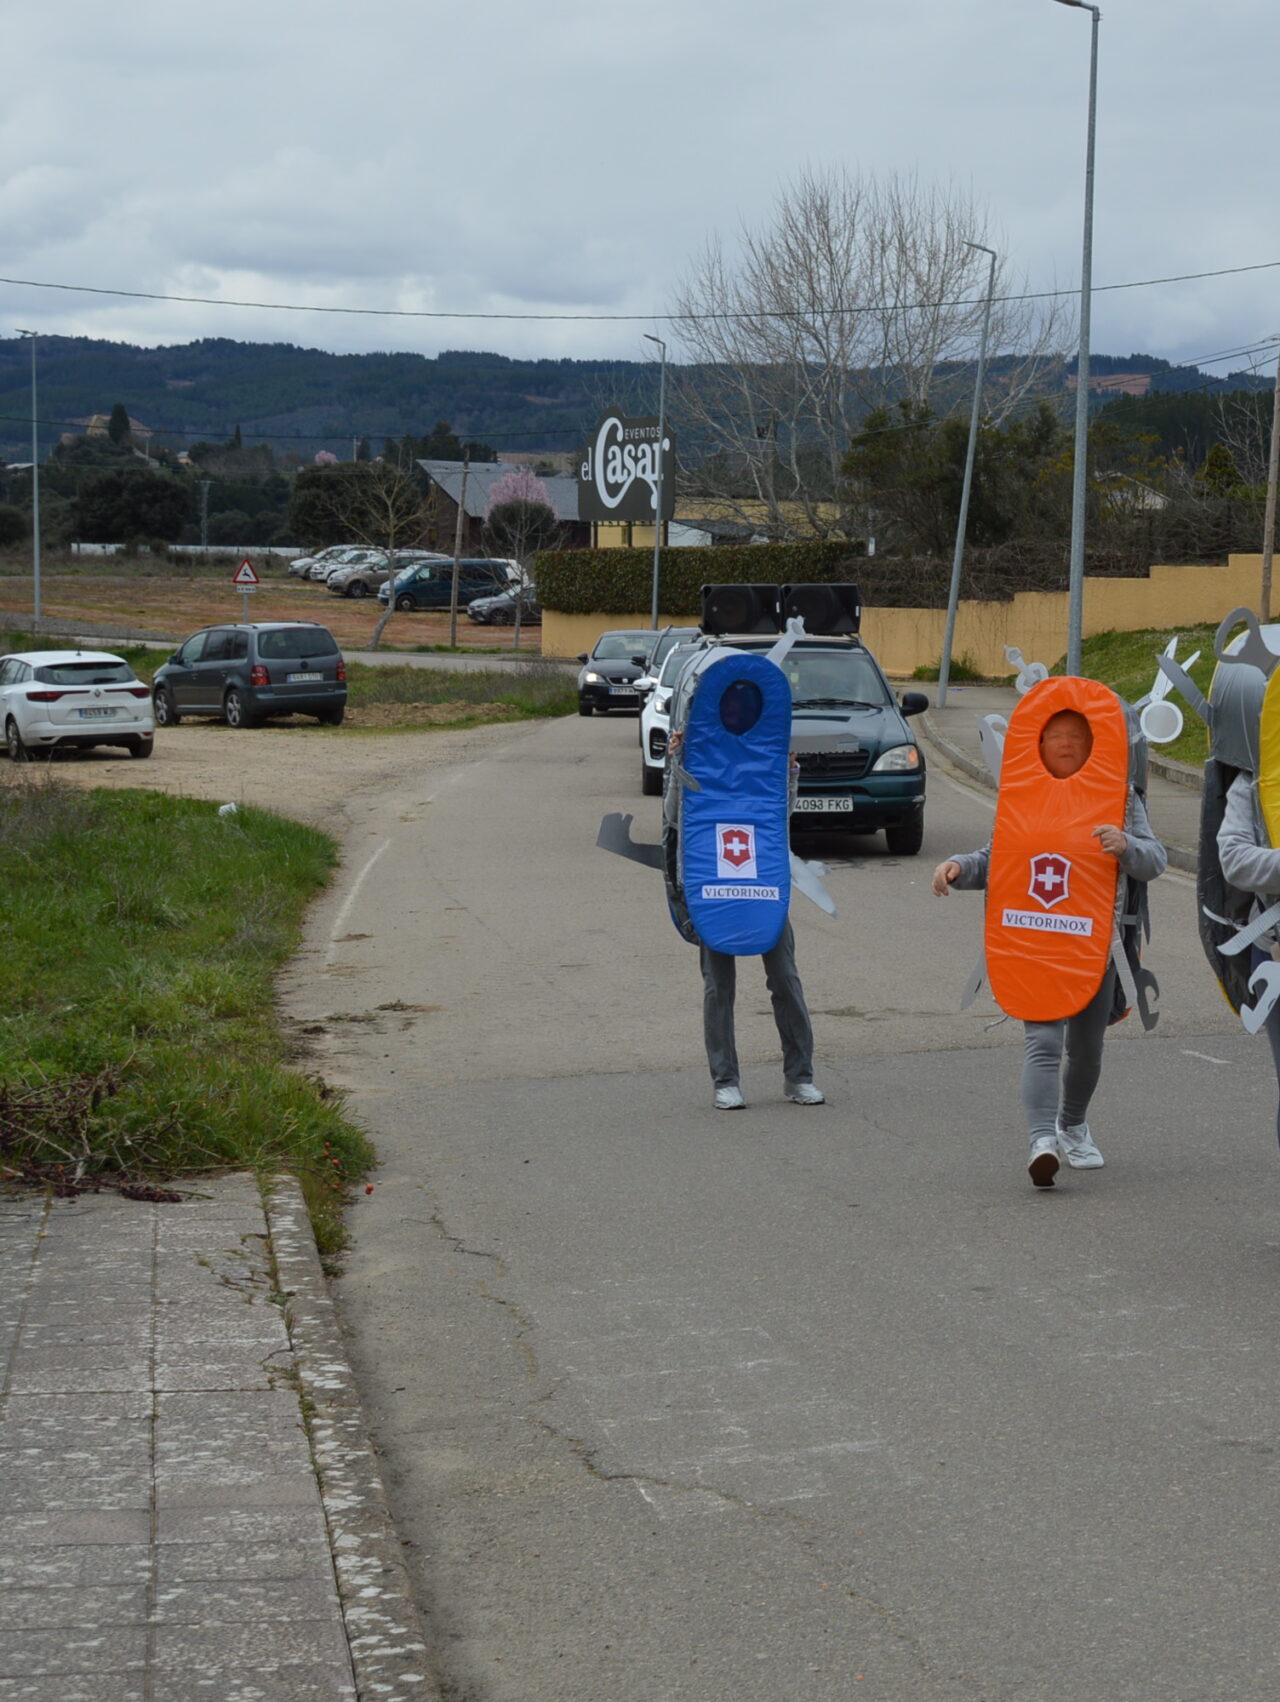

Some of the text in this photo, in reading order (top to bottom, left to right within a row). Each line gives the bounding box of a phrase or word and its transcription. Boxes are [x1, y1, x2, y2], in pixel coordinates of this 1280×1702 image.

[624, 427, 661, 440] EVENTOS
[581, 416, 671, 510] el Casar
[795, 799, 850, 811] 4093 FKG
[704, 887, 777, 899] VICTORINOX
[1005, 913, 1088, 933] VICTORINOX
